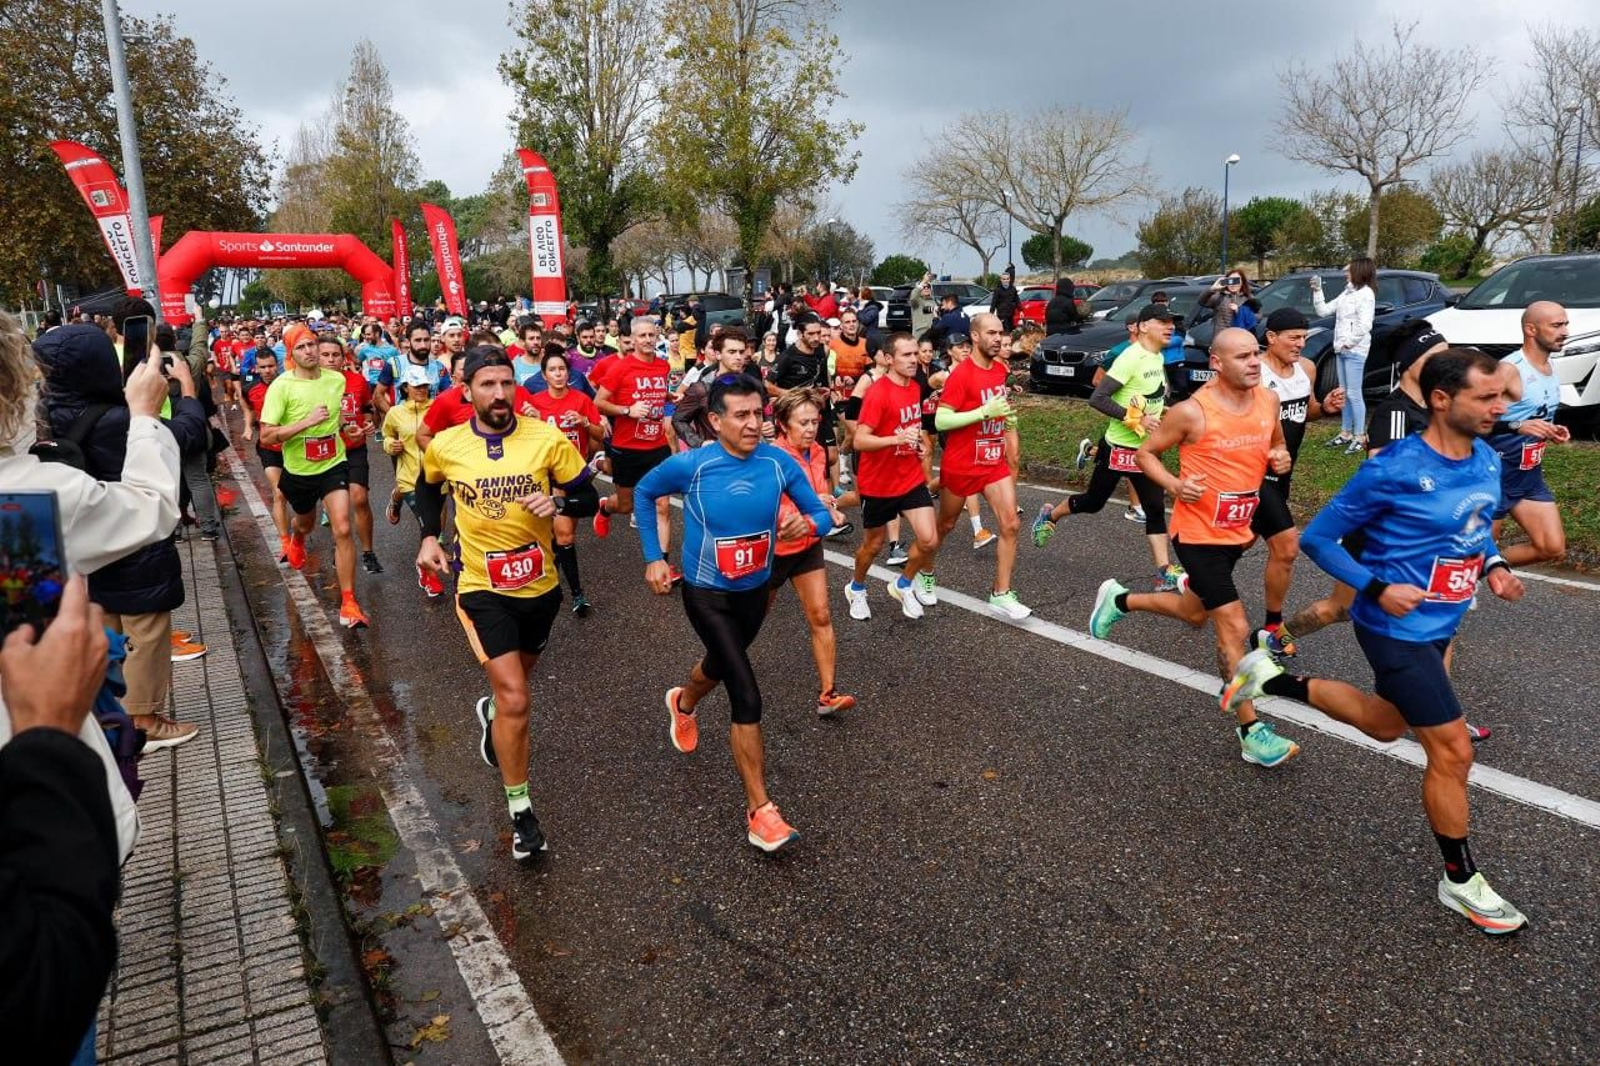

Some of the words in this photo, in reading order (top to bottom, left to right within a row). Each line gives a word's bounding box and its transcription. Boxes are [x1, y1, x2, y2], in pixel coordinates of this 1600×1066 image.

[219, 240, 258, 253] Sports
[275, 241, 334, 252] Santander
[475, 474, 533, 489] TANINOS
[1228, 503, 1254, 518] 217
[735, 546, 753, 566] 91
[501, 557, 533, 578] 430
